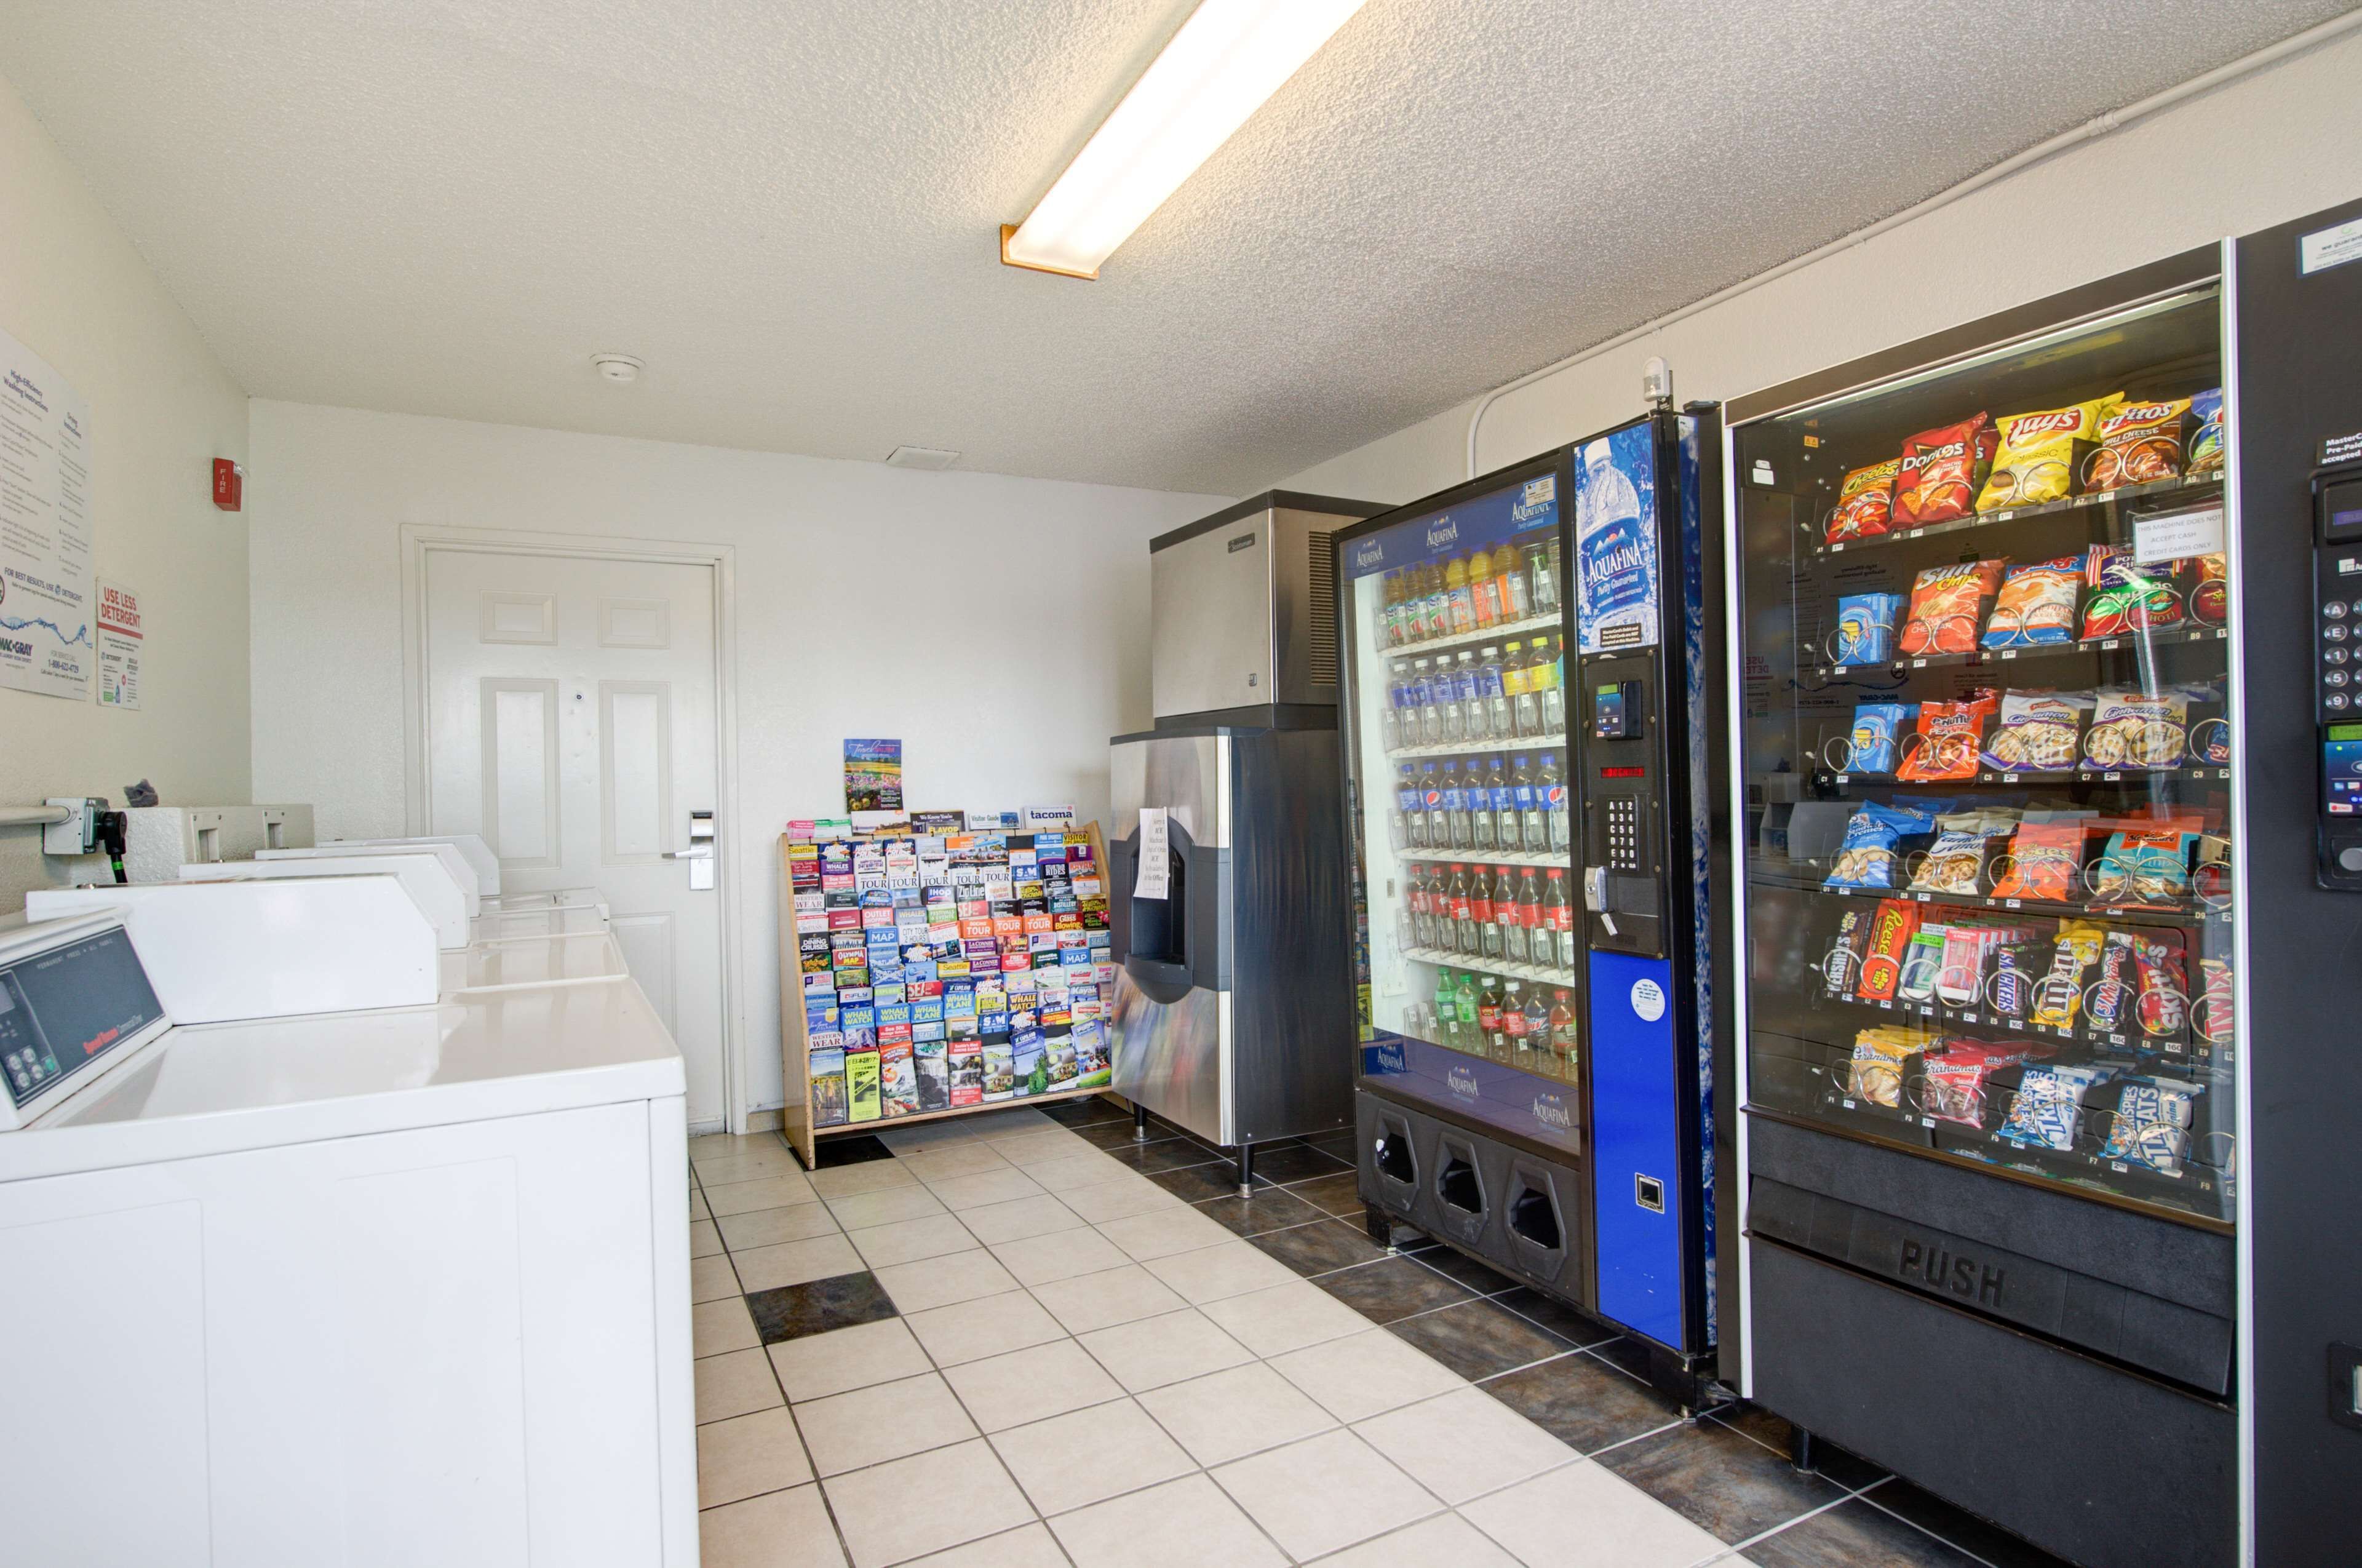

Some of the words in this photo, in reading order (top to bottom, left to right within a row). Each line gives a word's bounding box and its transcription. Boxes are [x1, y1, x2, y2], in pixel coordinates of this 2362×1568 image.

[2104, 403, 2173, 433] Fritos
[2010, 410, 2078, 442] Lay's
[2102, 434, 2120, 446] CHILI
[2122, 427, 2159, 439] CHEESE
[1902, 442, 1964, 472] Doritos
[2321, 450, 2361, 464] accepted
[1842, 461, 1898, 496] Cheetos
[2152, 520, 2185, 531] MACHINE
[2186, 517, 2205, 526] DOES
[2206, 514, 2221, 523] NOT
[1427, 521, 1458, 547] AQUAFINA
[2150, 533, 2176, 543] ACCEPT
[2144, 547, 2166, 556] CREDIT
[2168, 544, 2192, 553] CARDS
[2192, 542, 2211, 551] ONLY
[1357, 544, 1383, 567] AQUAFINA
[1589, 537, 1642, 581] AQUAFINA
[4, 567, 14, 577] FOR
[15, 571, 26, 581] BEST
[46, 583, 55, 591] USE
[1916, 561, 1978, 591] Sun
[1936, 573, 1981, 591] Chips
[103, 586, 119, 605] USE
[121, 591, 137, 611] LESS
[2331, 605, 2342, 615] A
[101, 603, 141, 629] DETERGENT
[2332, 628, 2341, 637] E
[2335, 651, 2340, 659] 1
[2332, 673, 2342, 683] 5
[2333, 696, 2342, 706] 9
[1609, 802, 1615, 810] A
[1619, 802, 1624, 810] 1
[1628, 802, 1633, 810] 2
[1031, 810, 1073, 819] tacoma
[1609, 813, 1615, 822] B
[1619, 813, 1624, 822] 3
[1628, 813, 1634, 822] 4
[1610, 825, 1615, 834] C
[1619, 825, 1624, 834] 5
[1628, 825, 1634, 834] 6
[1610, 837, 1616, 846] D
[1620, 837, 1624, 846] 7
[1629, 837, 1634, 846] 8
[1611, 849, 1616, 858] E
[1620, 849, 1625, 858] 9
[1629, 849, 1634, 858] 0
[1611, 861, 1616, 869] F
[923, 877, 949, 888] TOUR
[956, 875, 980, 885] TOUR
[985, 873, 1009, 882] TOUR
[861, 880, 887, 889] TOUR
[891, 878, 917, 888] TOUR
[996, 921, 1020, 931] TOUR
[1028, 920, 1051, 929] TOUR
[1841, 912, 1855, 933] LARGE
[1848, 917, 1857, 929] SIZE
[966, 926, 991, 935] TOUR
[872, 933, 895, 942] MAP
[838, 950, 864, 960] OLYMPIA
[1066, 954, 1087, 964] MAP
[1872, 970, 1882, 985] SIZE
[1880, 968, 1890, 990] LARGE
[1998, 952, 2016, 1014] SNICKERS
[1072, 985, 1097, 995] Kayak
[946, 993, 972, 1003] WHALE
[1010, 994, 1036, 1003] WHALE
[915, 1004, 941, 1013] WHALE
[945, 1000, 972, 1009] PLANE
[1010, 1002, 1036, 1011] WATCH
[845, 1009, 873, 1019] WHALE
[881, 1006, 909, 1015] WHALE
[914, 1011, 940, 1020] PLANE
[845, 1016, 873, 1025] WATCH
[813, 1038, 841, 1048] WEAR
[2142, 1040, 2151, 1048] E8
[1378, 1047, 1404, 1071] AQUAFINA
[1447, 1070, 1479, 1097] AQUAFINA
[1533, 1097, 1570, 1127] AQUAFINA
[1899, 1238, 2005, 1308] PUSH
